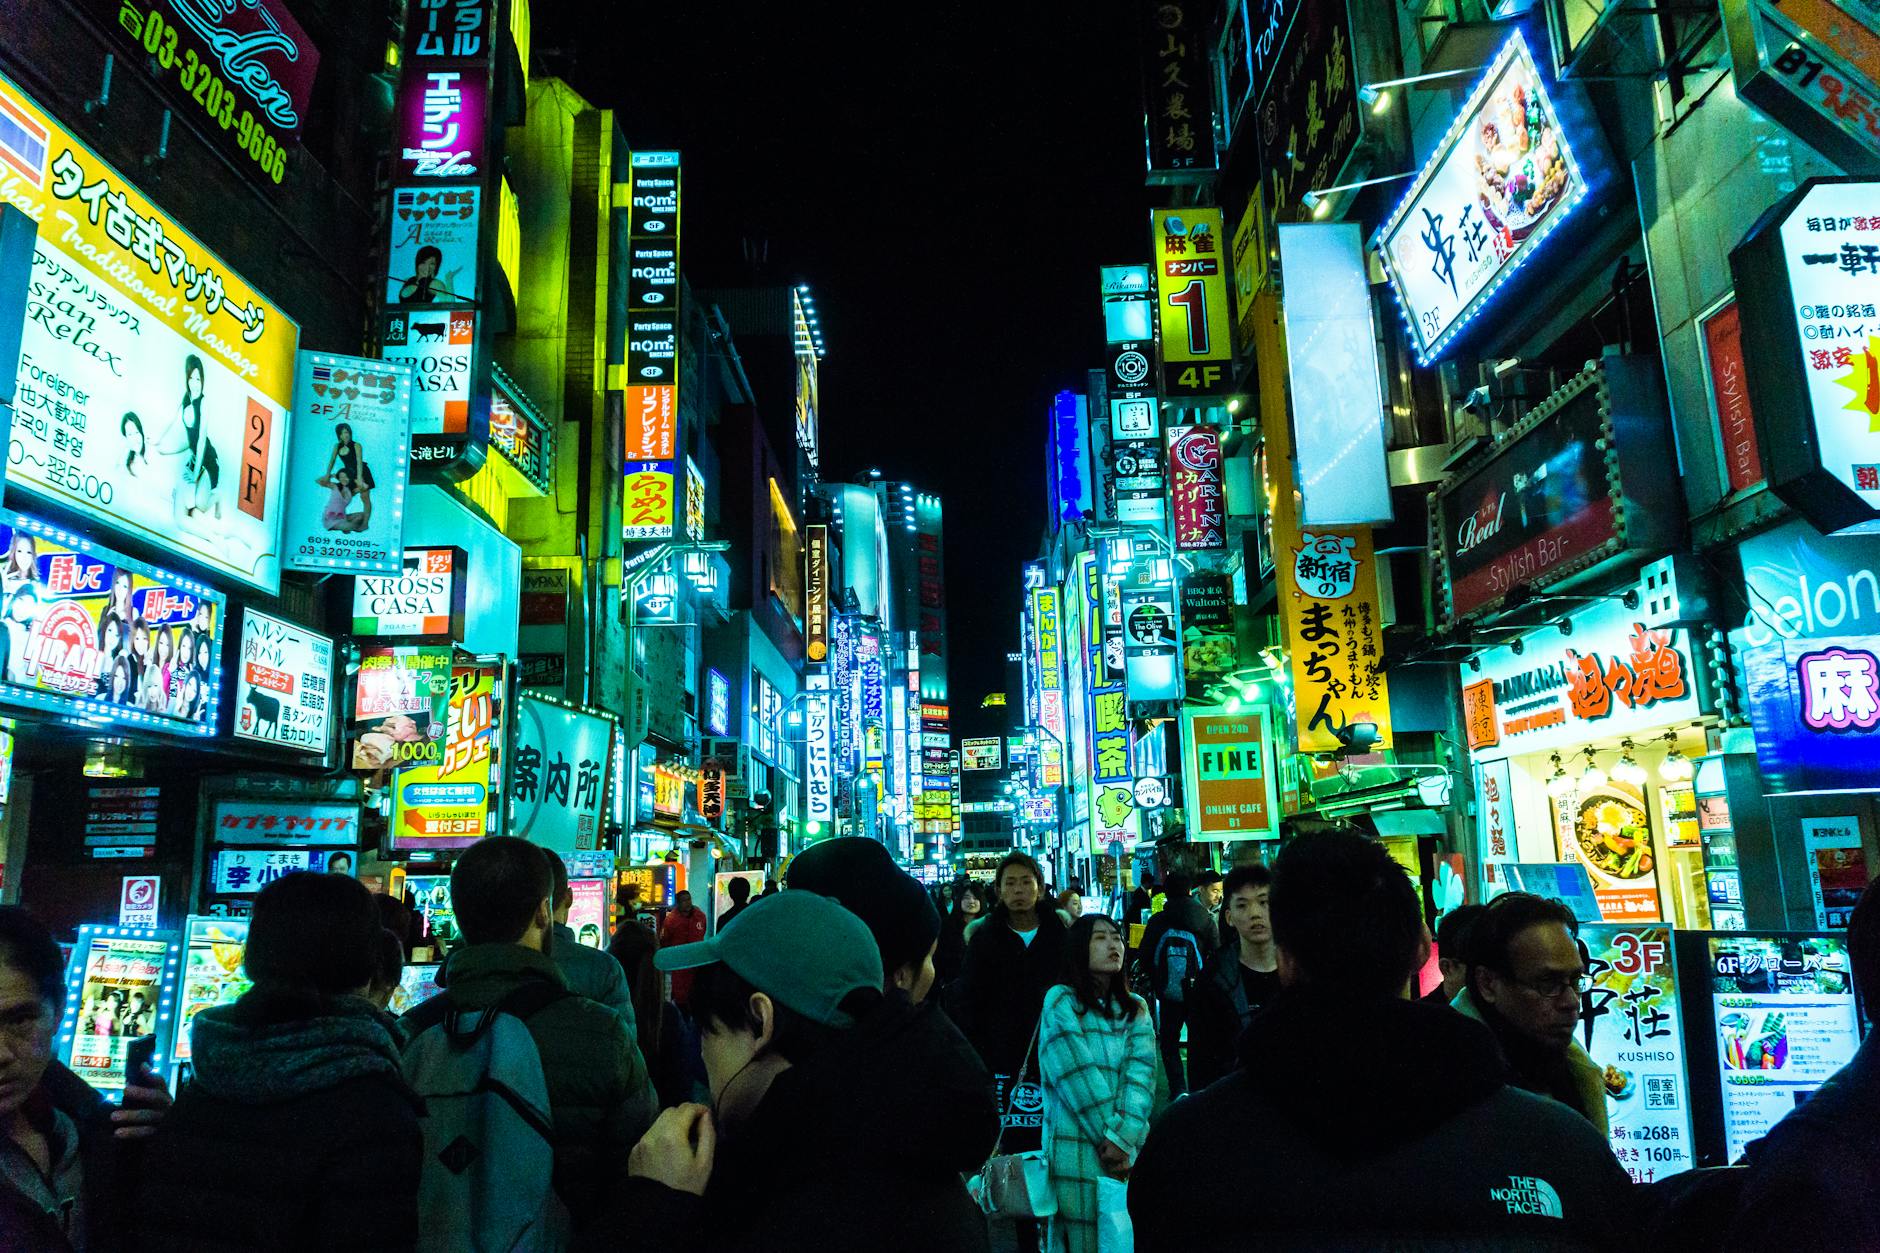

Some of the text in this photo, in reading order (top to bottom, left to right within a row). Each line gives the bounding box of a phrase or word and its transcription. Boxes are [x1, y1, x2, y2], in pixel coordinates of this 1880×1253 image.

[144, 10, 287, 184] 03-3203-9666
[421, 72, 462, 149] エデン
[413, 151, 477, 176] Eden
[52, 149, 265, 343] タイ古式マッサージ
[1165, 233, 1215, 254] 麻雀
[1168, 262, 1216, 273] ナンバー
[32, 249, 140, 336] アジアンリラックス
[56, 210, 259, 378] Traditional Massage
[1169, 279, 1210, 355] 1
[1422, 306, 1442, 340] 3F
[27, 301, 123, 378] Relax
[20, 353, 90, 406] Foreigner
[1178, 366, 1221, 389] 4F
[311, 403, 334, 415] 2F
[1170, 428, 1184, 438] 3F
[243, 414, 265, 504] 2F
[641, 463, 658, 471] 1F
[631, 474, 667, 525] らーめん
[1185, 470, 1202, 541] カリーナ
[307, 536, 330, 545] 60分
[625, 526, 671, 537] 博多天神
[50, 556, 104, 592] 話して
[1298, 555, 1352, 584] 新宿
[361, 577, 444, 596] XROSS
[1318, 582, 1337, 597] の
[371, 597, 435, 615] CASA
[1186, 596, 1226, 607] Walton's
[247, 618, 300, 644] ヘルシー
[1300, 602, 1347, 739] まっちゃん
[866, 661, 881, 708] カラオケ
[1805, 654, 1878, 722] 麻
[1206, 725, 1229, 735] OPEN
[808, 683, 829, 814] とかつにいむら
[1203, 750, 1257, 773] FINE
[513, 744, 600, 812] 案内所
[1206, 803, 1262, 815] ONLINE CAFE
[236, 854, 301, 865] り こまき
[226, 866, 251, 889] 李
[1612, 932, 1665, 975] 3F
[1717, 953, 1842, 974] 6F クローバー
[1618, 1051, 1675, 1063] KUSHISO
[1648, 1079, 1674, 1092] 個室
[1649, 1092, 1675, 1106] 完備
[1508, 1175, 1536, 1190] THE
[1490, 1188, 1538, 1202] NORTH
[1506, 1200, 1542, 1215] FACE
